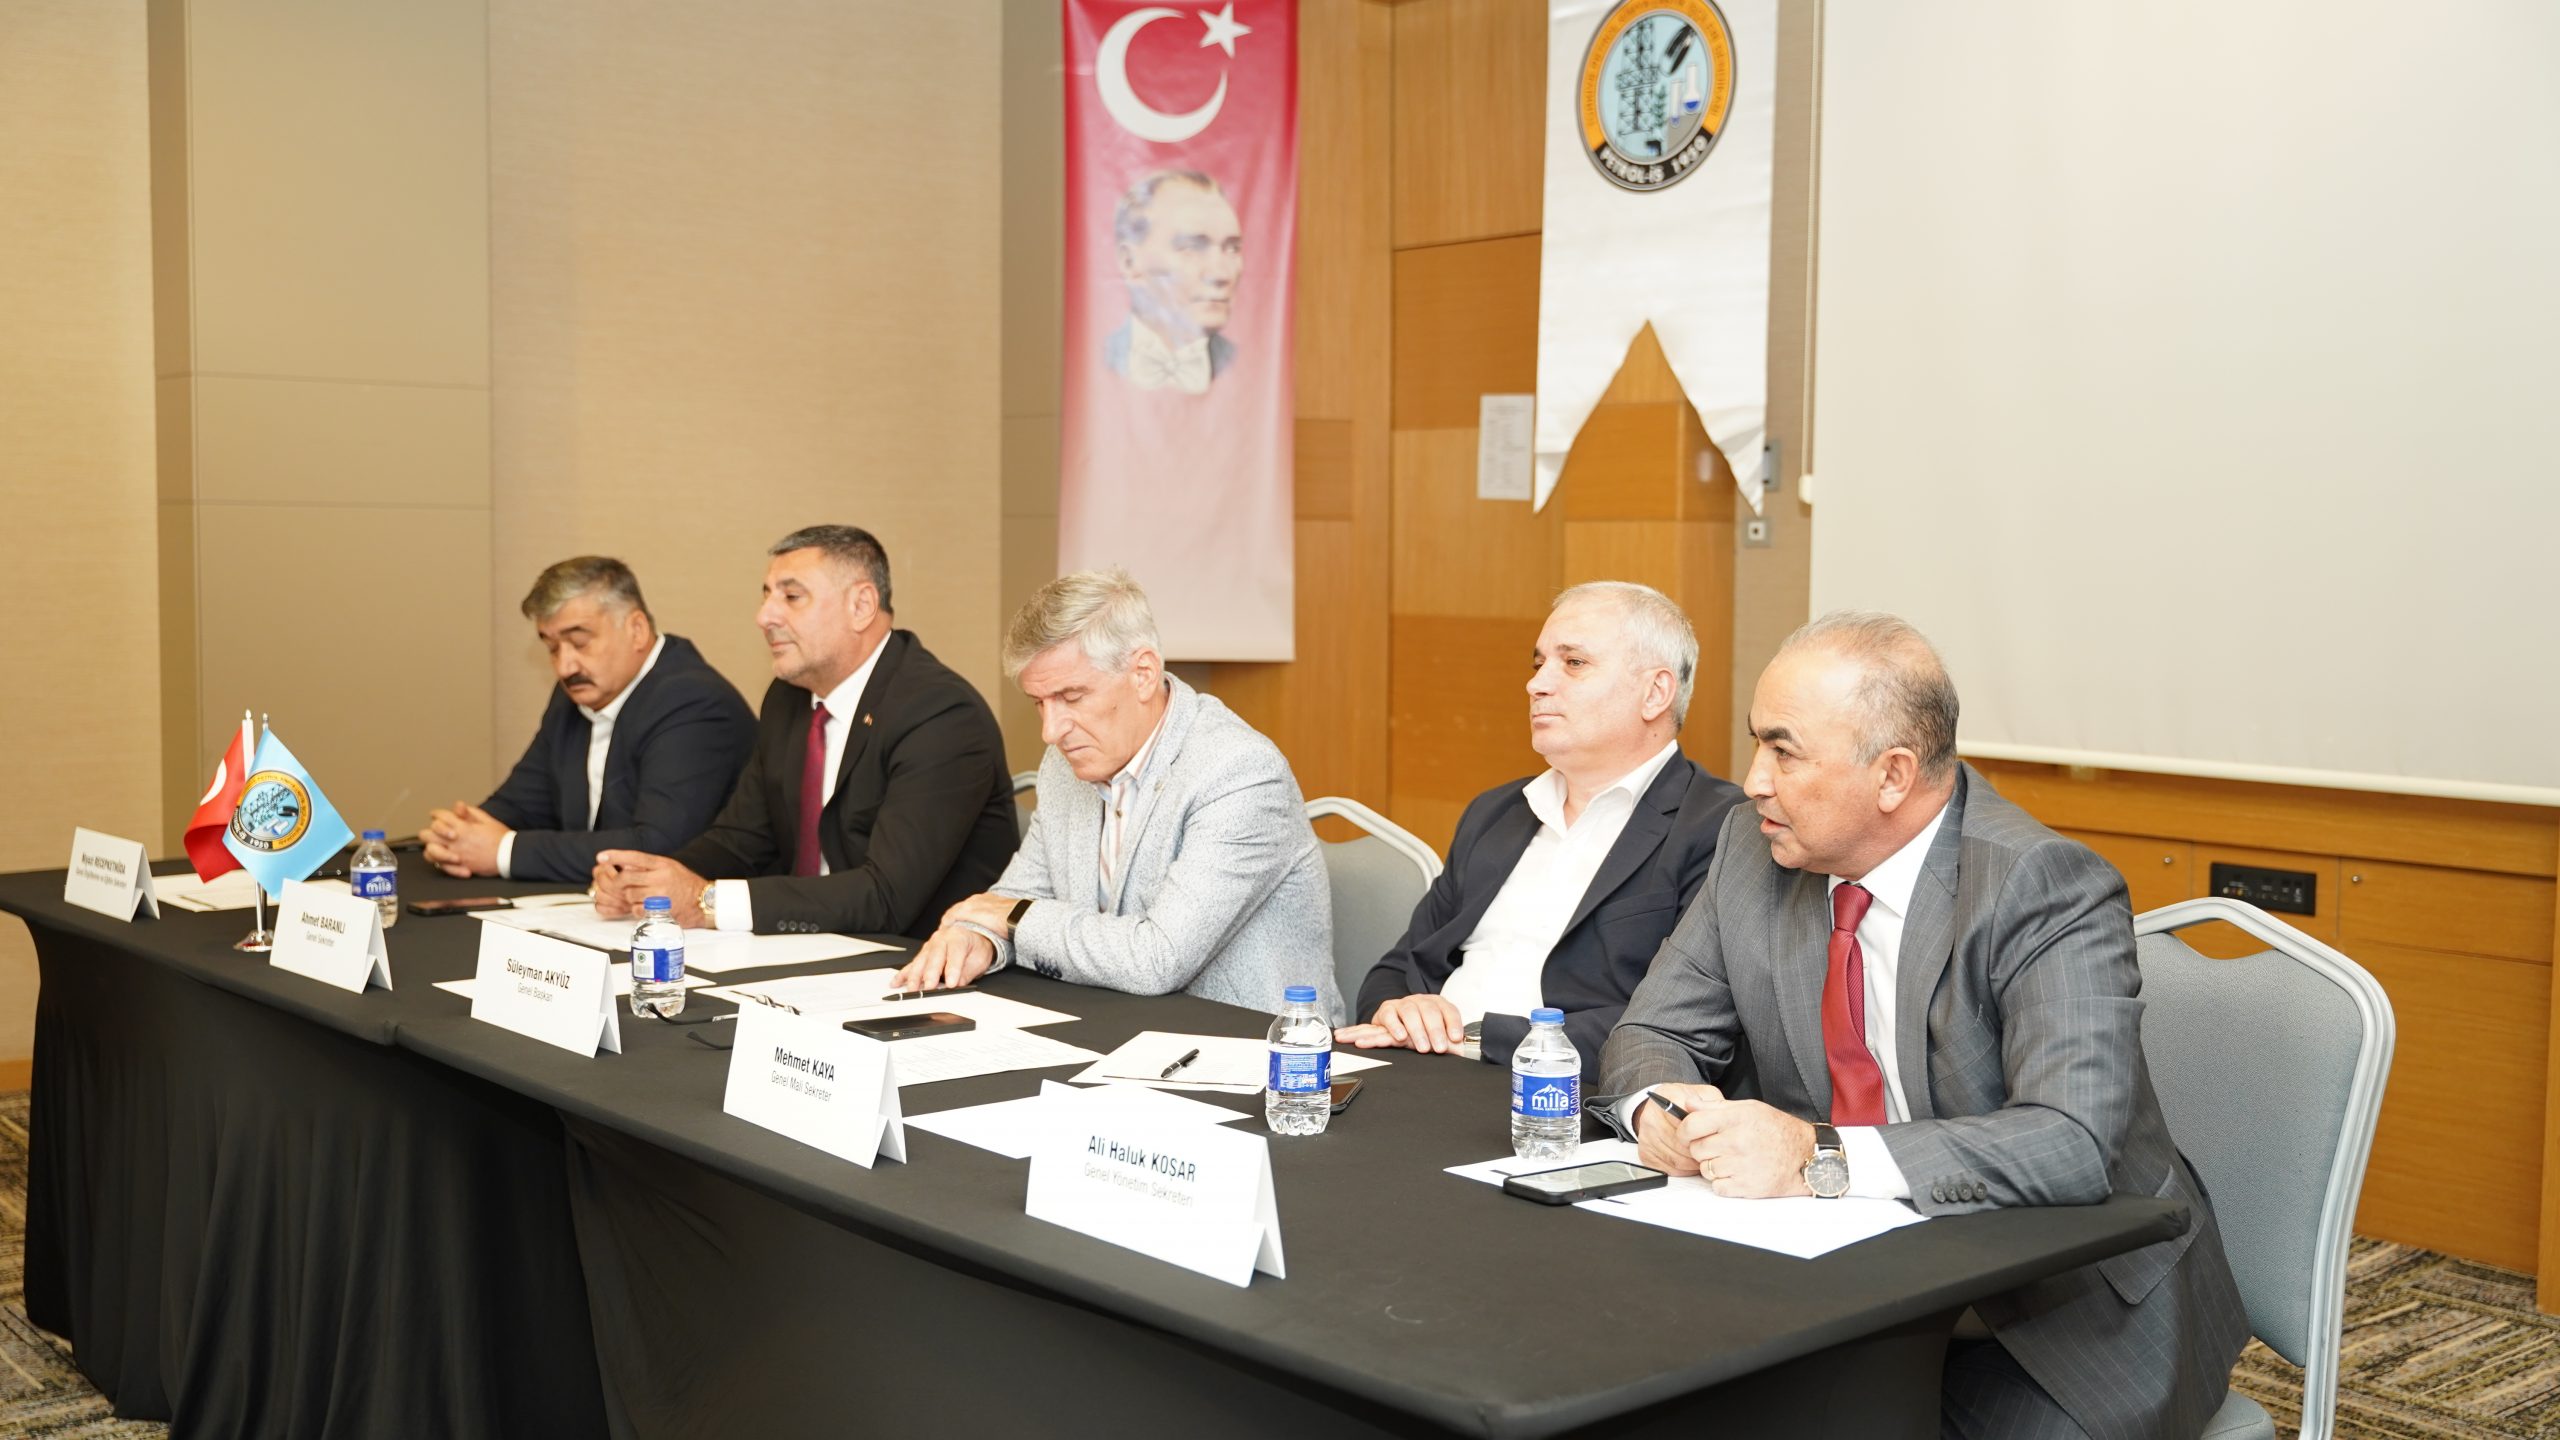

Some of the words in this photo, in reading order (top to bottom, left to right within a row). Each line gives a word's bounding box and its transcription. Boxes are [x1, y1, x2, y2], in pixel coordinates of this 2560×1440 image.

[506, 958, 543, 981] Süleyman
[544, 970, 571, 989] AKYÜZ
[517, 981, 532, 996] Genel
[771, 1070, 789, 1087] Genel
[774, 1046, 811, 1073] Mehmet
[811, 1059, 835, 1082] KAYA
[1532, 1092, 1569, 1108] mila
[1088, 1135, 1106, 1156] Ali
[1109, 1140, 1147, 1168] Haluk
[1151, 1152, 1196, 1182] KOŞAR
[1084, 1161, 1110, 1182] Genel
[1112, 1169, 1148, 1193] Yönetim
